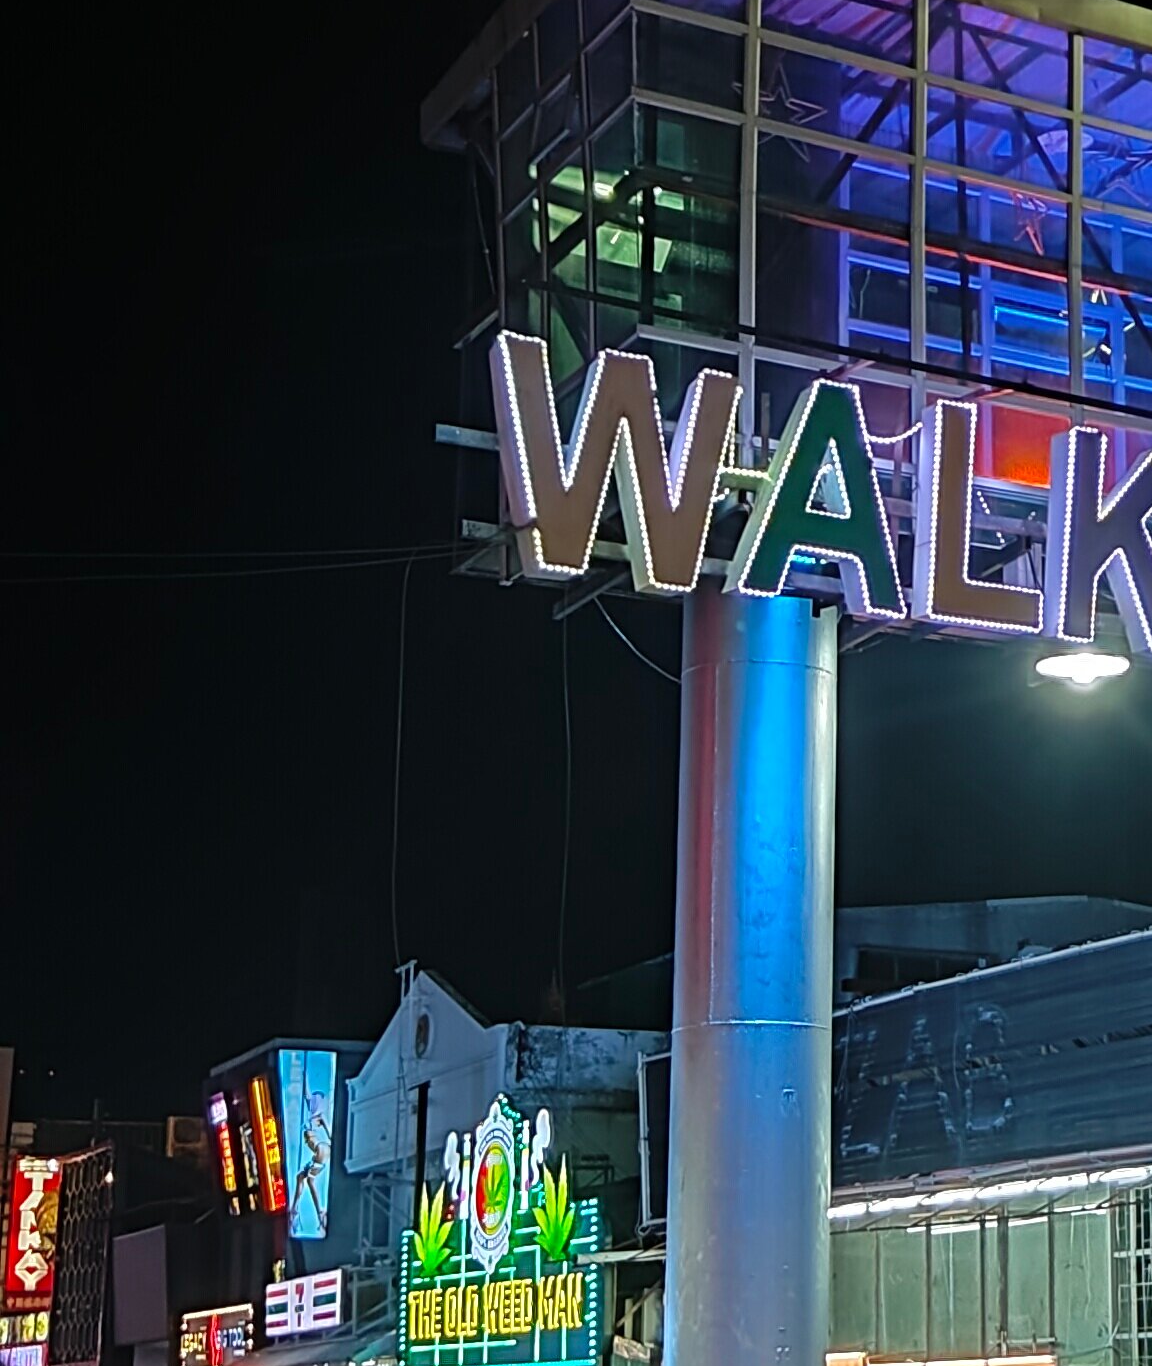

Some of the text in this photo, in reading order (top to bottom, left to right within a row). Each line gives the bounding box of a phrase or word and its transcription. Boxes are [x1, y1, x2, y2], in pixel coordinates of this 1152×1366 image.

[408, 1288, 443, 1340] THE
[444, 1284, 479, 1338] OLD
[482, 1277, 533, 1335] WEED
